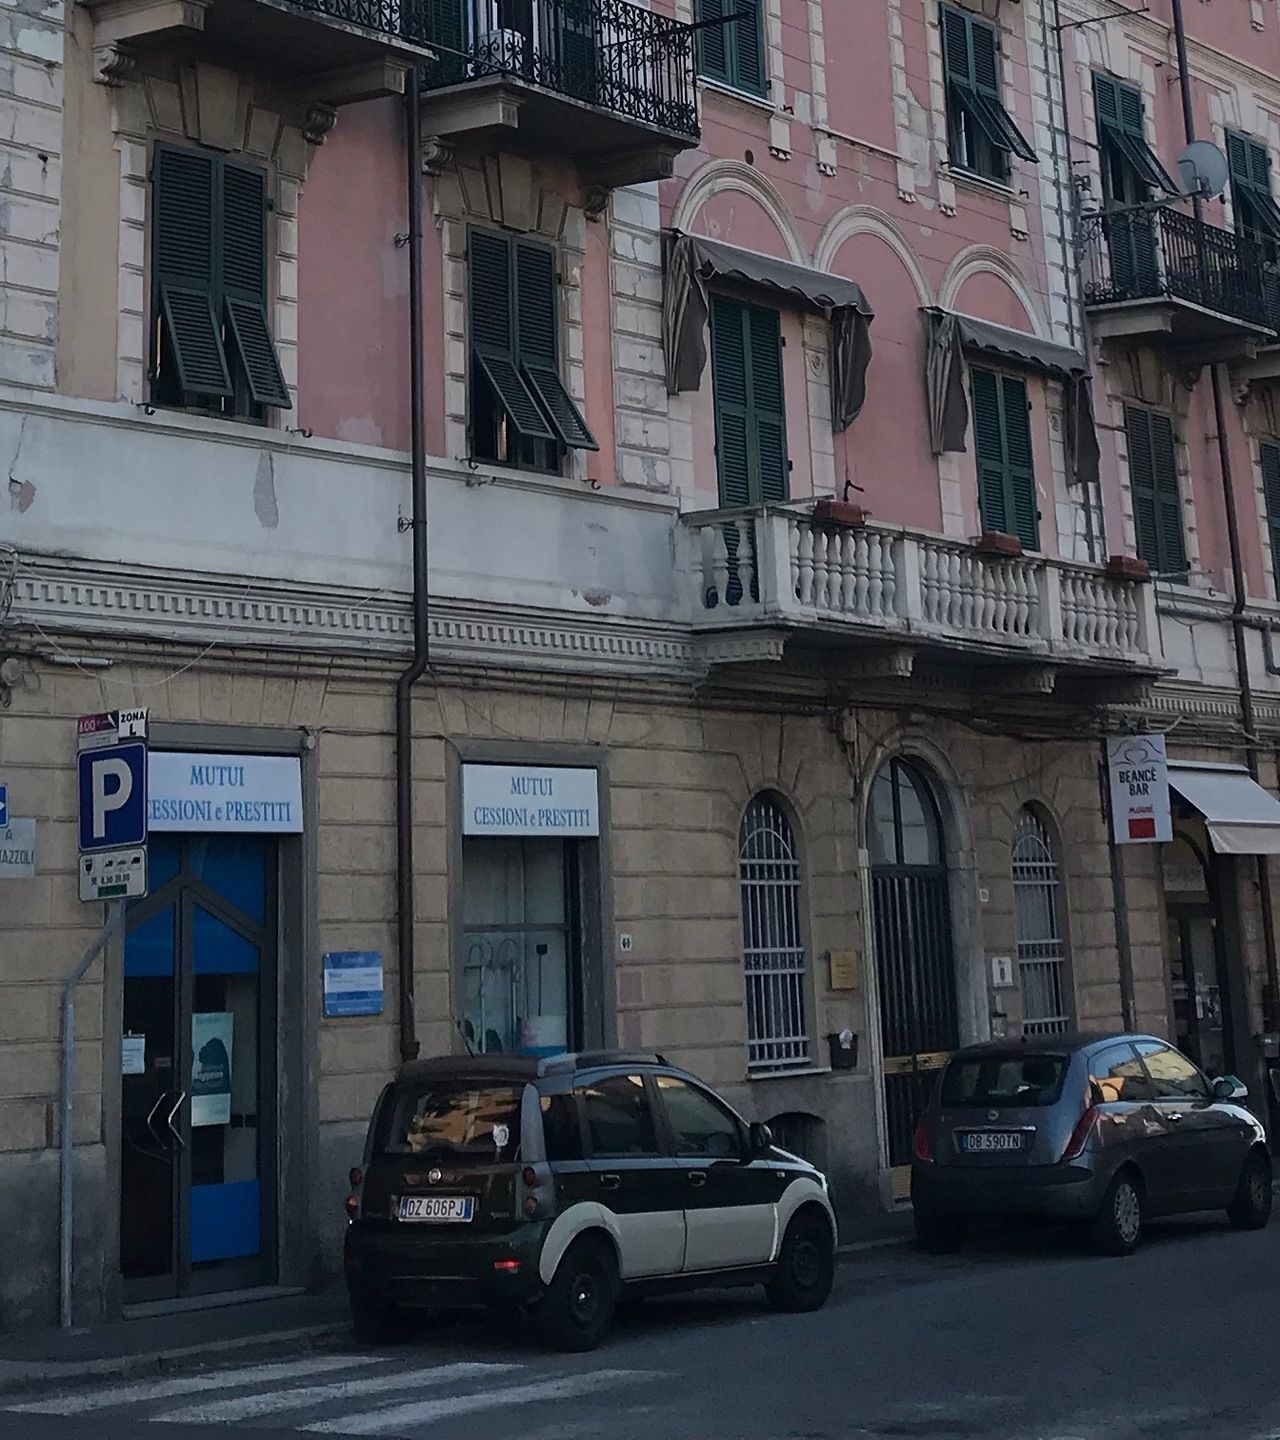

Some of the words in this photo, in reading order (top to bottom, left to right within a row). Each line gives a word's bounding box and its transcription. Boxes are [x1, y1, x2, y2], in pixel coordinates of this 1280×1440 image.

[121, 711, 145, 723] ZONA
[130, 723, 136, 736] L
[190, 765, 245, 786] MUTUI
[510, 776, 553, 796] MUTUI
[1129, 783, 1149, 796] BAR
[92, 758, 133, 839] P
[216, 807, 223, 821] e
[226, 801, 291, 821] PRESTITI
[474, 807, 528, 826] CESSIONI
[530, 814, 536, 827] e
[538, 809, 590, 827] PRESTITI
[408, 1200, 422, 1216] DZ
[425, 1199, 464, 1216] 606PJ
